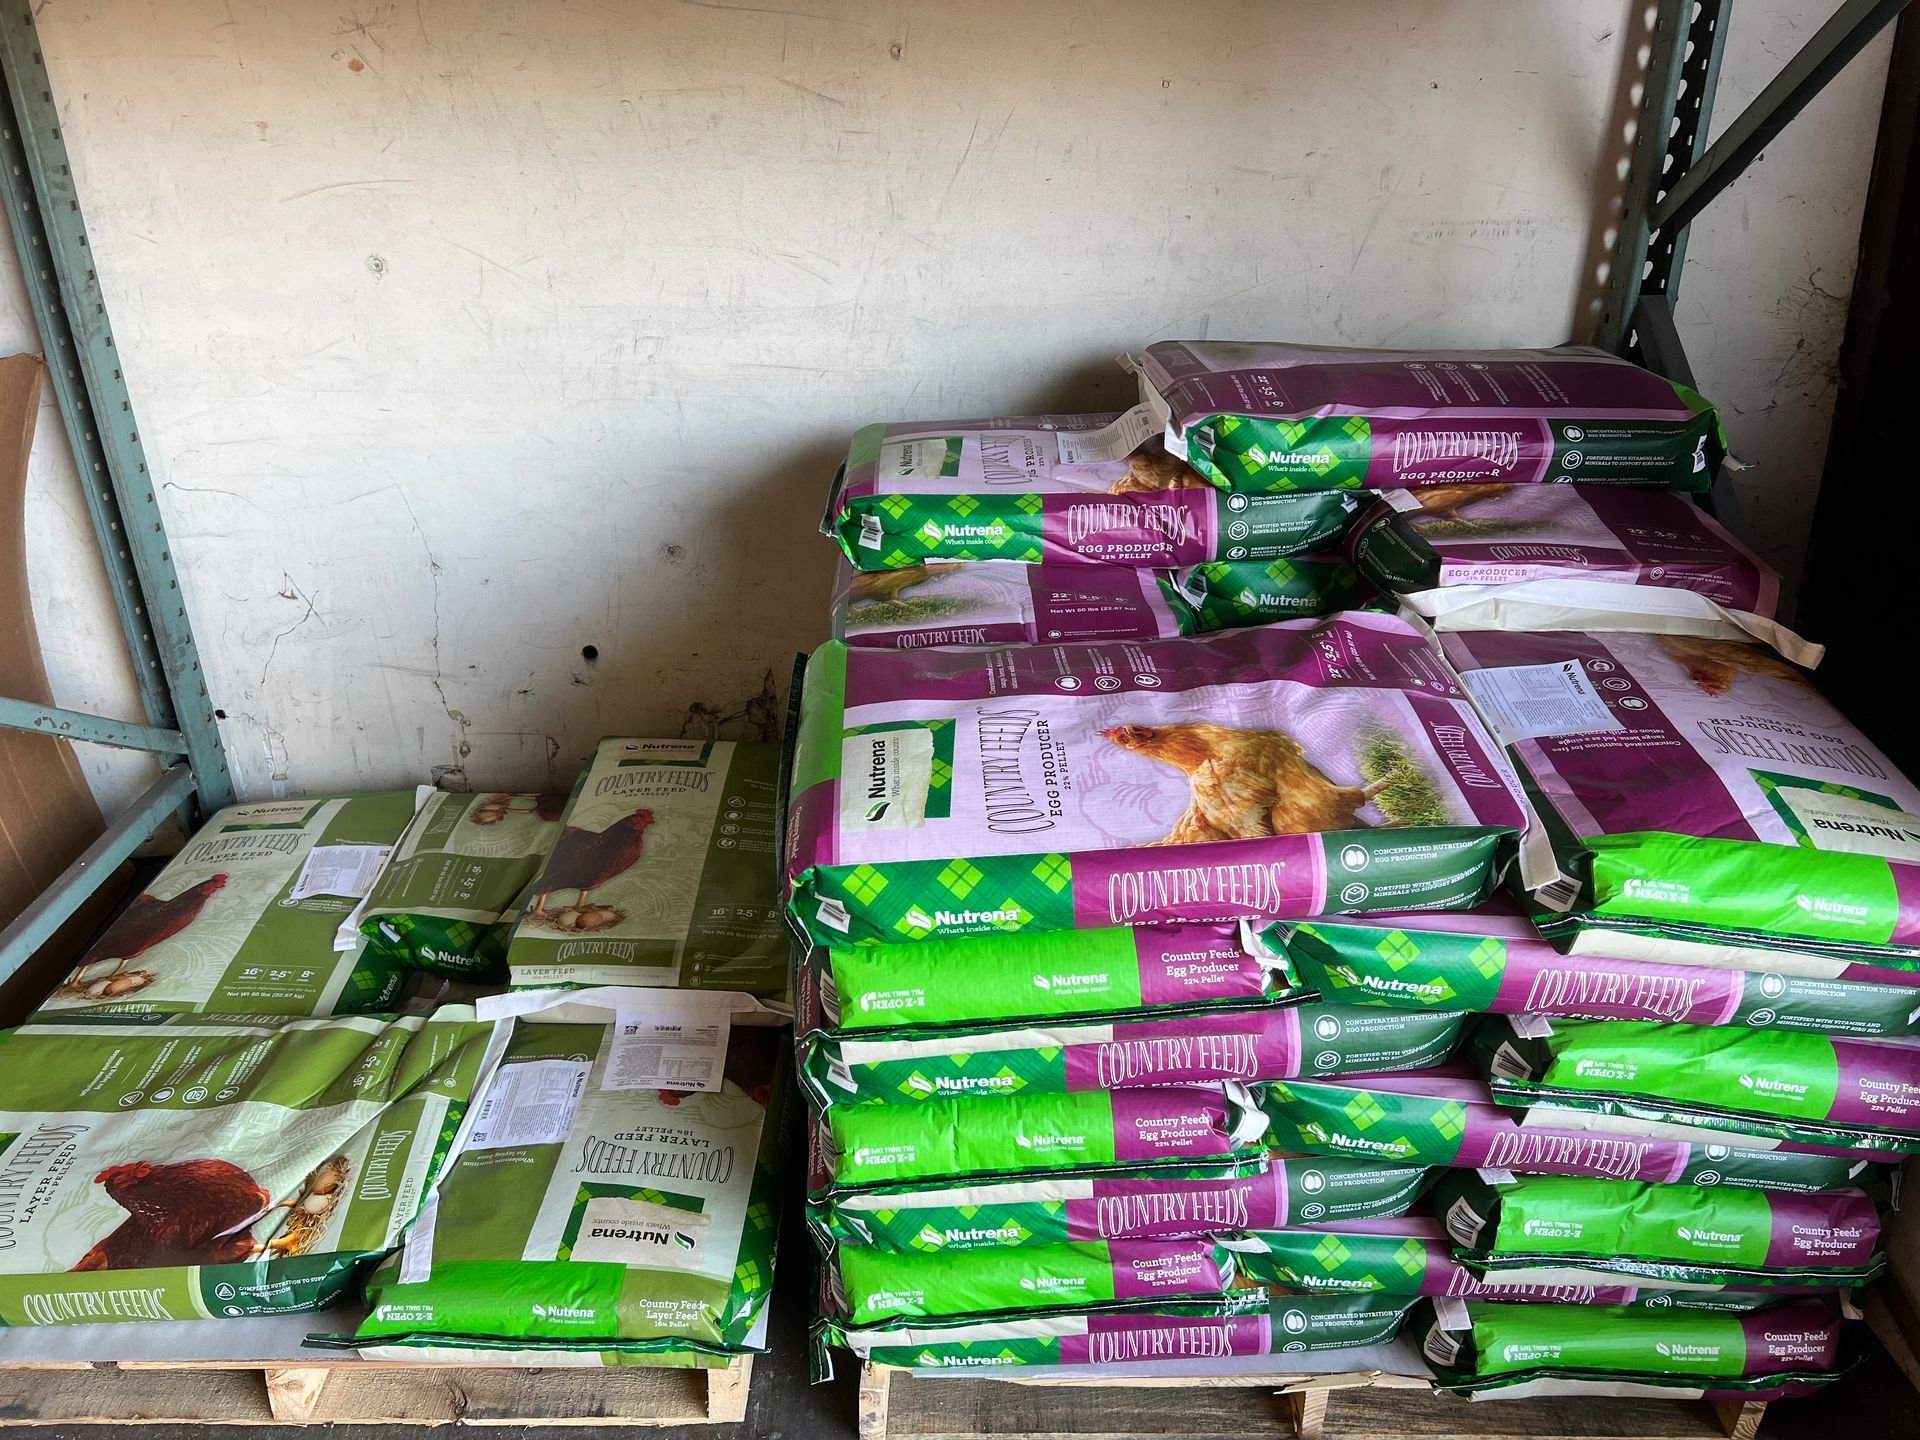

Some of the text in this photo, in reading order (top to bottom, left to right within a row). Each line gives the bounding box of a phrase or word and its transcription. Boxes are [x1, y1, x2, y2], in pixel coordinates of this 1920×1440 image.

[1269, 451, 1330, 465] Nutrena
[1393, 431, 1520, 473] COUNTRY FEEDS
[944, 524, 1004, 537] Nutrena
[1068, 503, 1186, 547] COUNTRY FEEDS
[1077, 542, 1173, 553] EGG PRODUCER
[1490, 545, 1588, 566] COUNTRY FEEDS
[1449, 568, 1528, 577] EGG PRODUCER
[1260, 594, 1317, 607] Nutrena
[897, 628, 986, 649] COUNTRY FEEDS
[1708, 718, 1806, 737] PRODUCER
[642, 743, 695, 752] Nutrena
[1429, 720, 1502, 787] COUNTRY FEEDS
[1697, 719, 1890, 780] COUNTRY FEEDS
[867, 739, 886, 799] Nutrena
[977, 710, 1054, 834] COUNTRY FEEDS
[1037, 720, 1062, 817] EGG PRODUCER
[596, 770, 711, 797] COUNTRY FEEDS
[252, 806, 304, 815] Nutrena
[1813, 818, 1907, 841] Nutrena
[1108, 862, 1281, 923] COUNTRY FEEDS
[1814, 898, 1867, 916] Nutrena
[935, 909, 1018, 925] Nutrena
[557, 942, 636, 962] COUNTRY FEEDS
[1161, 949, 1240, 964] Country Feeds
[1166, 962, 1239, 977] Egg Producer
[1052, 973, 1107, 987] Nutrena
[1201, 975, 1225, 983] Pellet
[1363, 976, 1445, 995] Nutrena
[1524, 968, 1700, 1022] COUNTRY FEEDS
[1790, 980, 1841, 989] CONCENTRATED
[1843, 983, 1878, 993] NUTRITION
[1889, 987, 1917, 996] SUPPORT
[1804, 989, 1846, 997] PRODUCTION
[873, 997, 925, 1010] E-Z OPEN
[1098, 1034, 1258, 1088] COUNTRY FEEDS
[1584, 1069, 1615, 1078] OPEN
[935, 1075, 1013, 1090] Nutrena
[1755, 1077, 1807, 1094] Nutrena
[1859, 1078, 1900, 1093] Country
[1859, 1091, 1920, 1107] Egg Produce
[1135, 1114, 1209, 1128] Country Feeds
[614, 1133, 710, 1148] LAYER FEED
[1034, 1135, 1083, 1146] Nutrena
[1139, 1126, 1208, 1141] Egg Producer
[9, 1125, 91, 1166] FEEDS
[1331, 1133, 1408, 1154] Nutrena
[576, 1135, 734, 1184] COUNTRY FEEDS
[866, 1152, 915, 1165] E-Z OPEN
[1483, 1131, 1648, 1180] COUNTRY FEEDS
[359, 1130, 412, 1200] COUNTRY FEEDS
[19, 1144, 77, 1223] LAYER FEED
[1098, 1188, 1248, 1238] COUNTRY FEEDS
[591, 1228, 670, 1245] Nutrena
[945, 1228, 1019, 1241] Nutrena
[1533, 1228, 1559, 1236] OPEN
[1693, 1229, 1742, 1242] Nutrena
[1792, 1226, 1860, 1238] Country Feeds
[1794, 1237, 1857, 1249] Egg Producer
[1133, 1253, 1202, 1270] Country Feeds
[1137, 1266, 1200, 1281] Egg Producer
[1037, 1278, 1085, 1286] Nutrena
[1304, 1275, 1375, 1288] Nutrena
[24, 1288, 172, 1325] COUNTRY FEEDS
[548, 1306, 594, 1317] Nutrena
[640, 1300, 704, 1311] Country Feeds
[386, 1311, 434, 1321] E-Z OPEN
[646, 1311, 698, 1322] Layer Feed
[1089, 1324, 1234, 1364] COUNTRY FEEDS
[1764, 1332, 1829, 1343] Country Feeds
[1672, 1344, 1720, 1355] Nutrena
[1768, 1344, 1825, 1355] Egg Producer
[944, 1355, 1013, 1365] Nutrena
